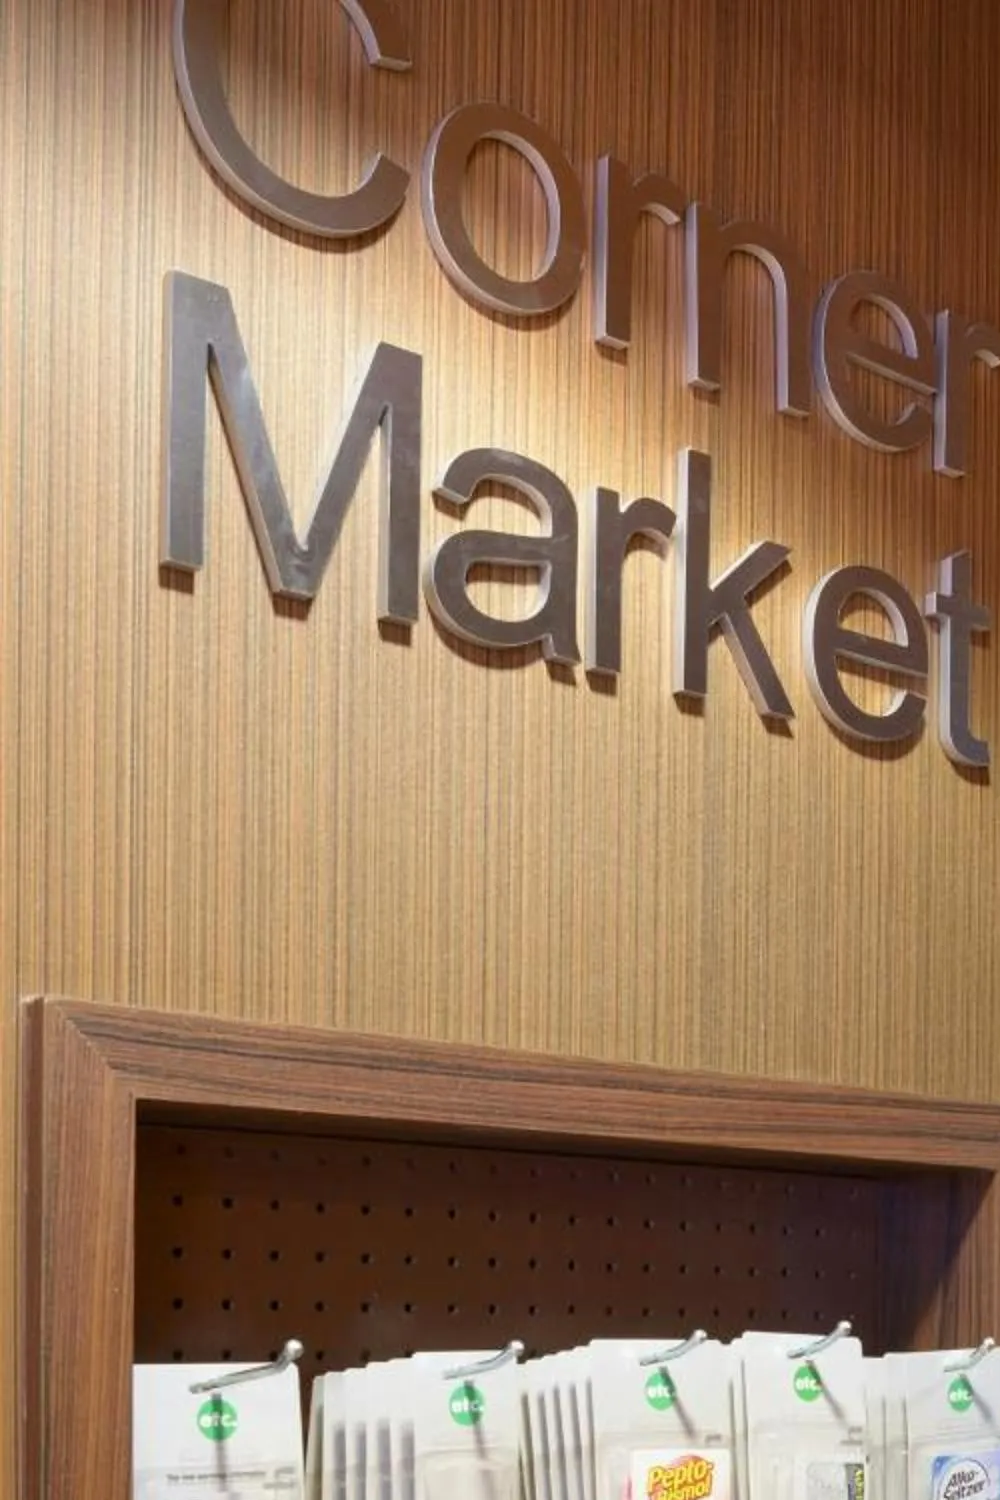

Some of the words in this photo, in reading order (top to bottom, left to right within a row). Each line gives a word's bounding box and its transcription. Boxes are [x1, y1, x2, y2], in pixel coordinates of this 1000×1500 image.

[159, 269, 991, 769] Market
[796, 1378, 822, 1391] etc.
[200, 1411, 238, 1429] etc.
